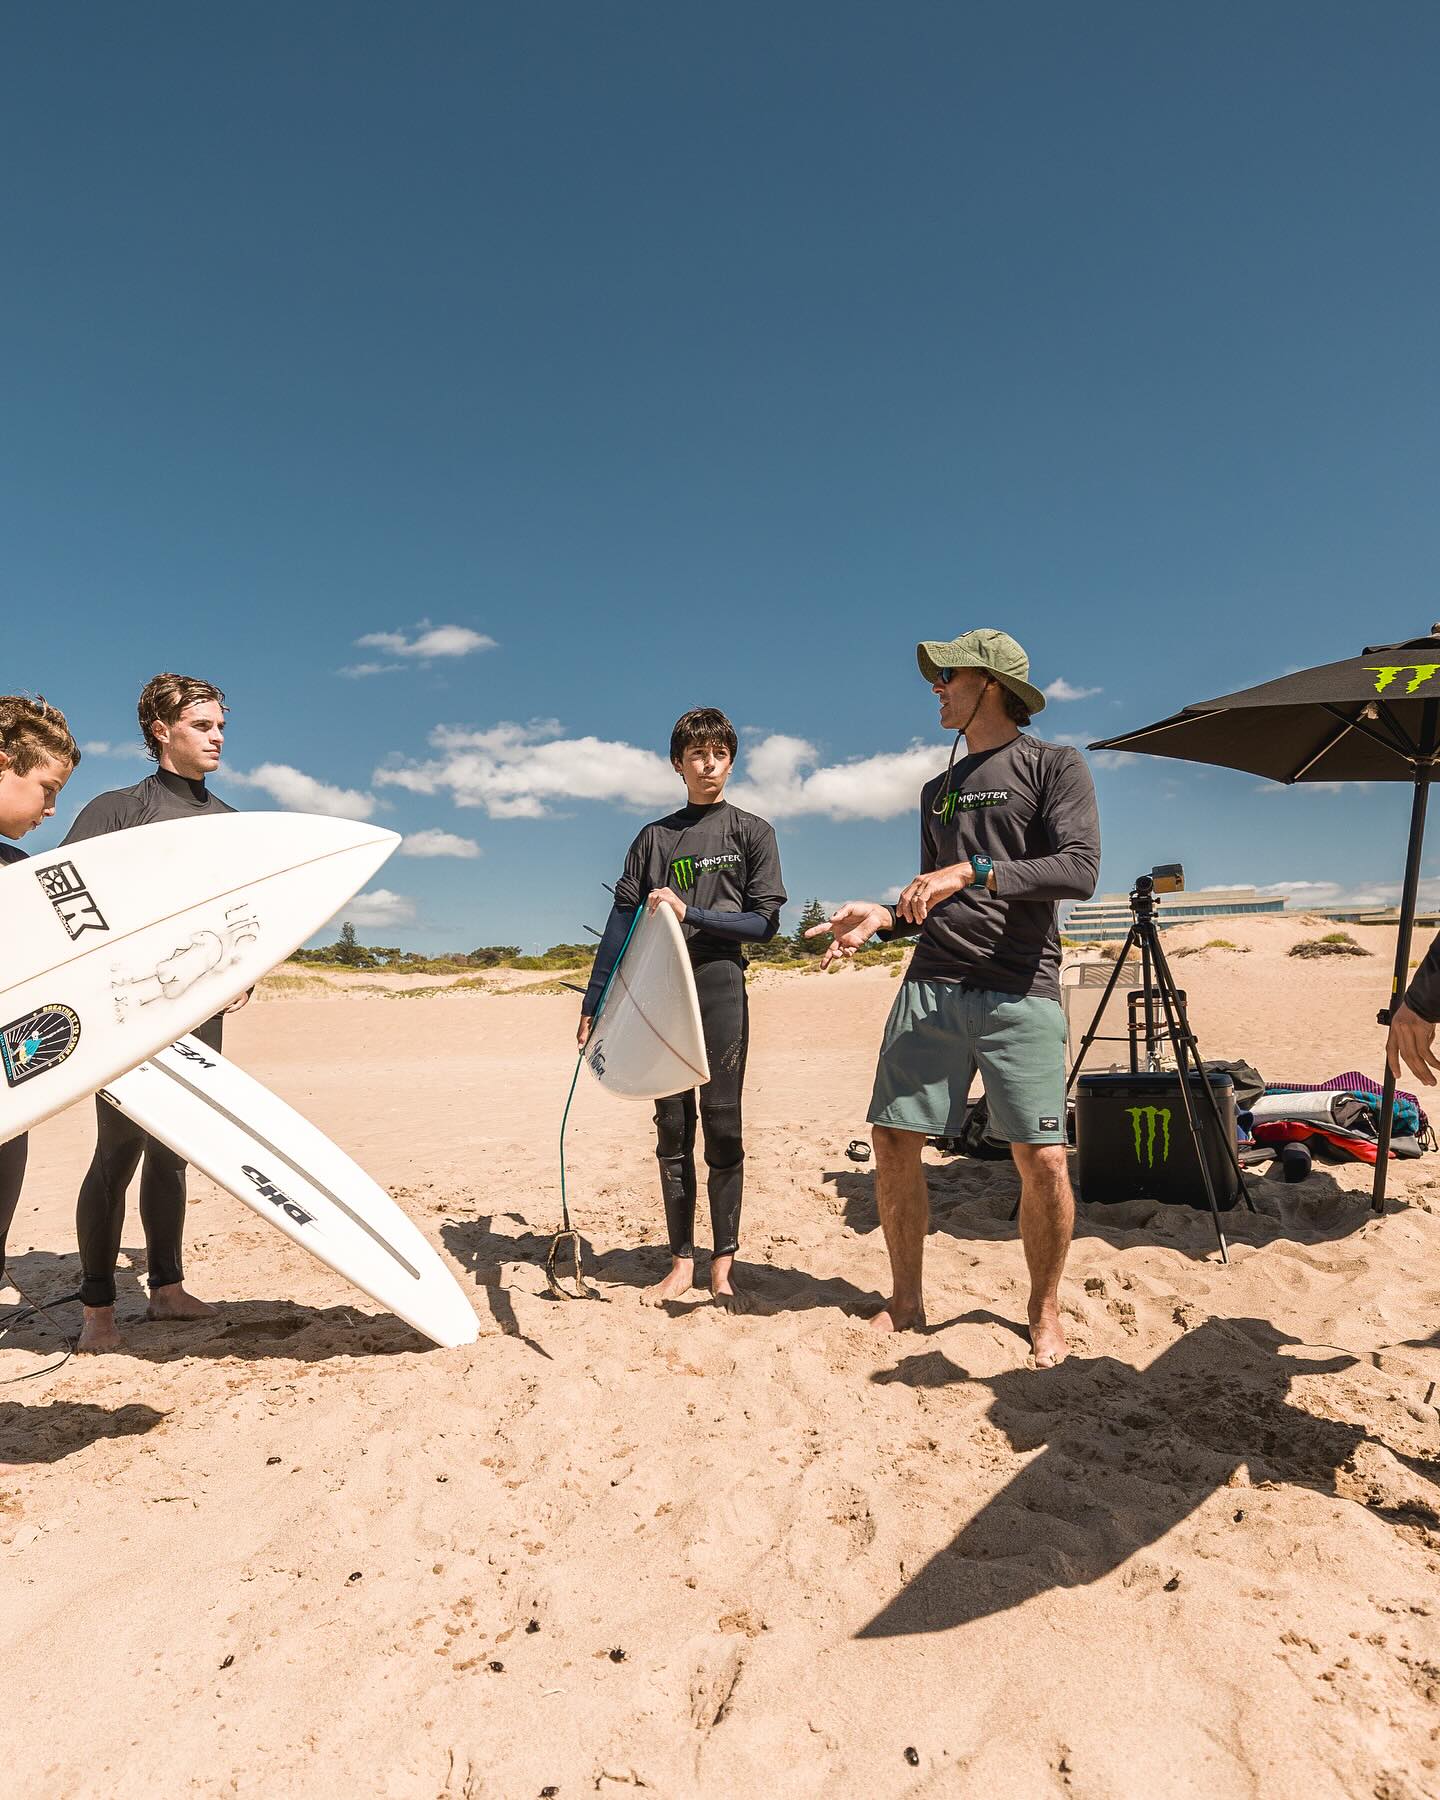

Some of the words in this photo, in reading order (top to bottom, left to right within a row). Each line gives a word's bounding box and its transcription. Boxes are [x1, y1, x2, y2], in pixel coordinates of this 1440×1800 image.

[958, 791, 1008, 804] MONSTER
[694, 854, 742, 869] MONSTER
[42, 1004, 74, 1018] BREATHE
[241, 1165, 314, 1226] DHD
